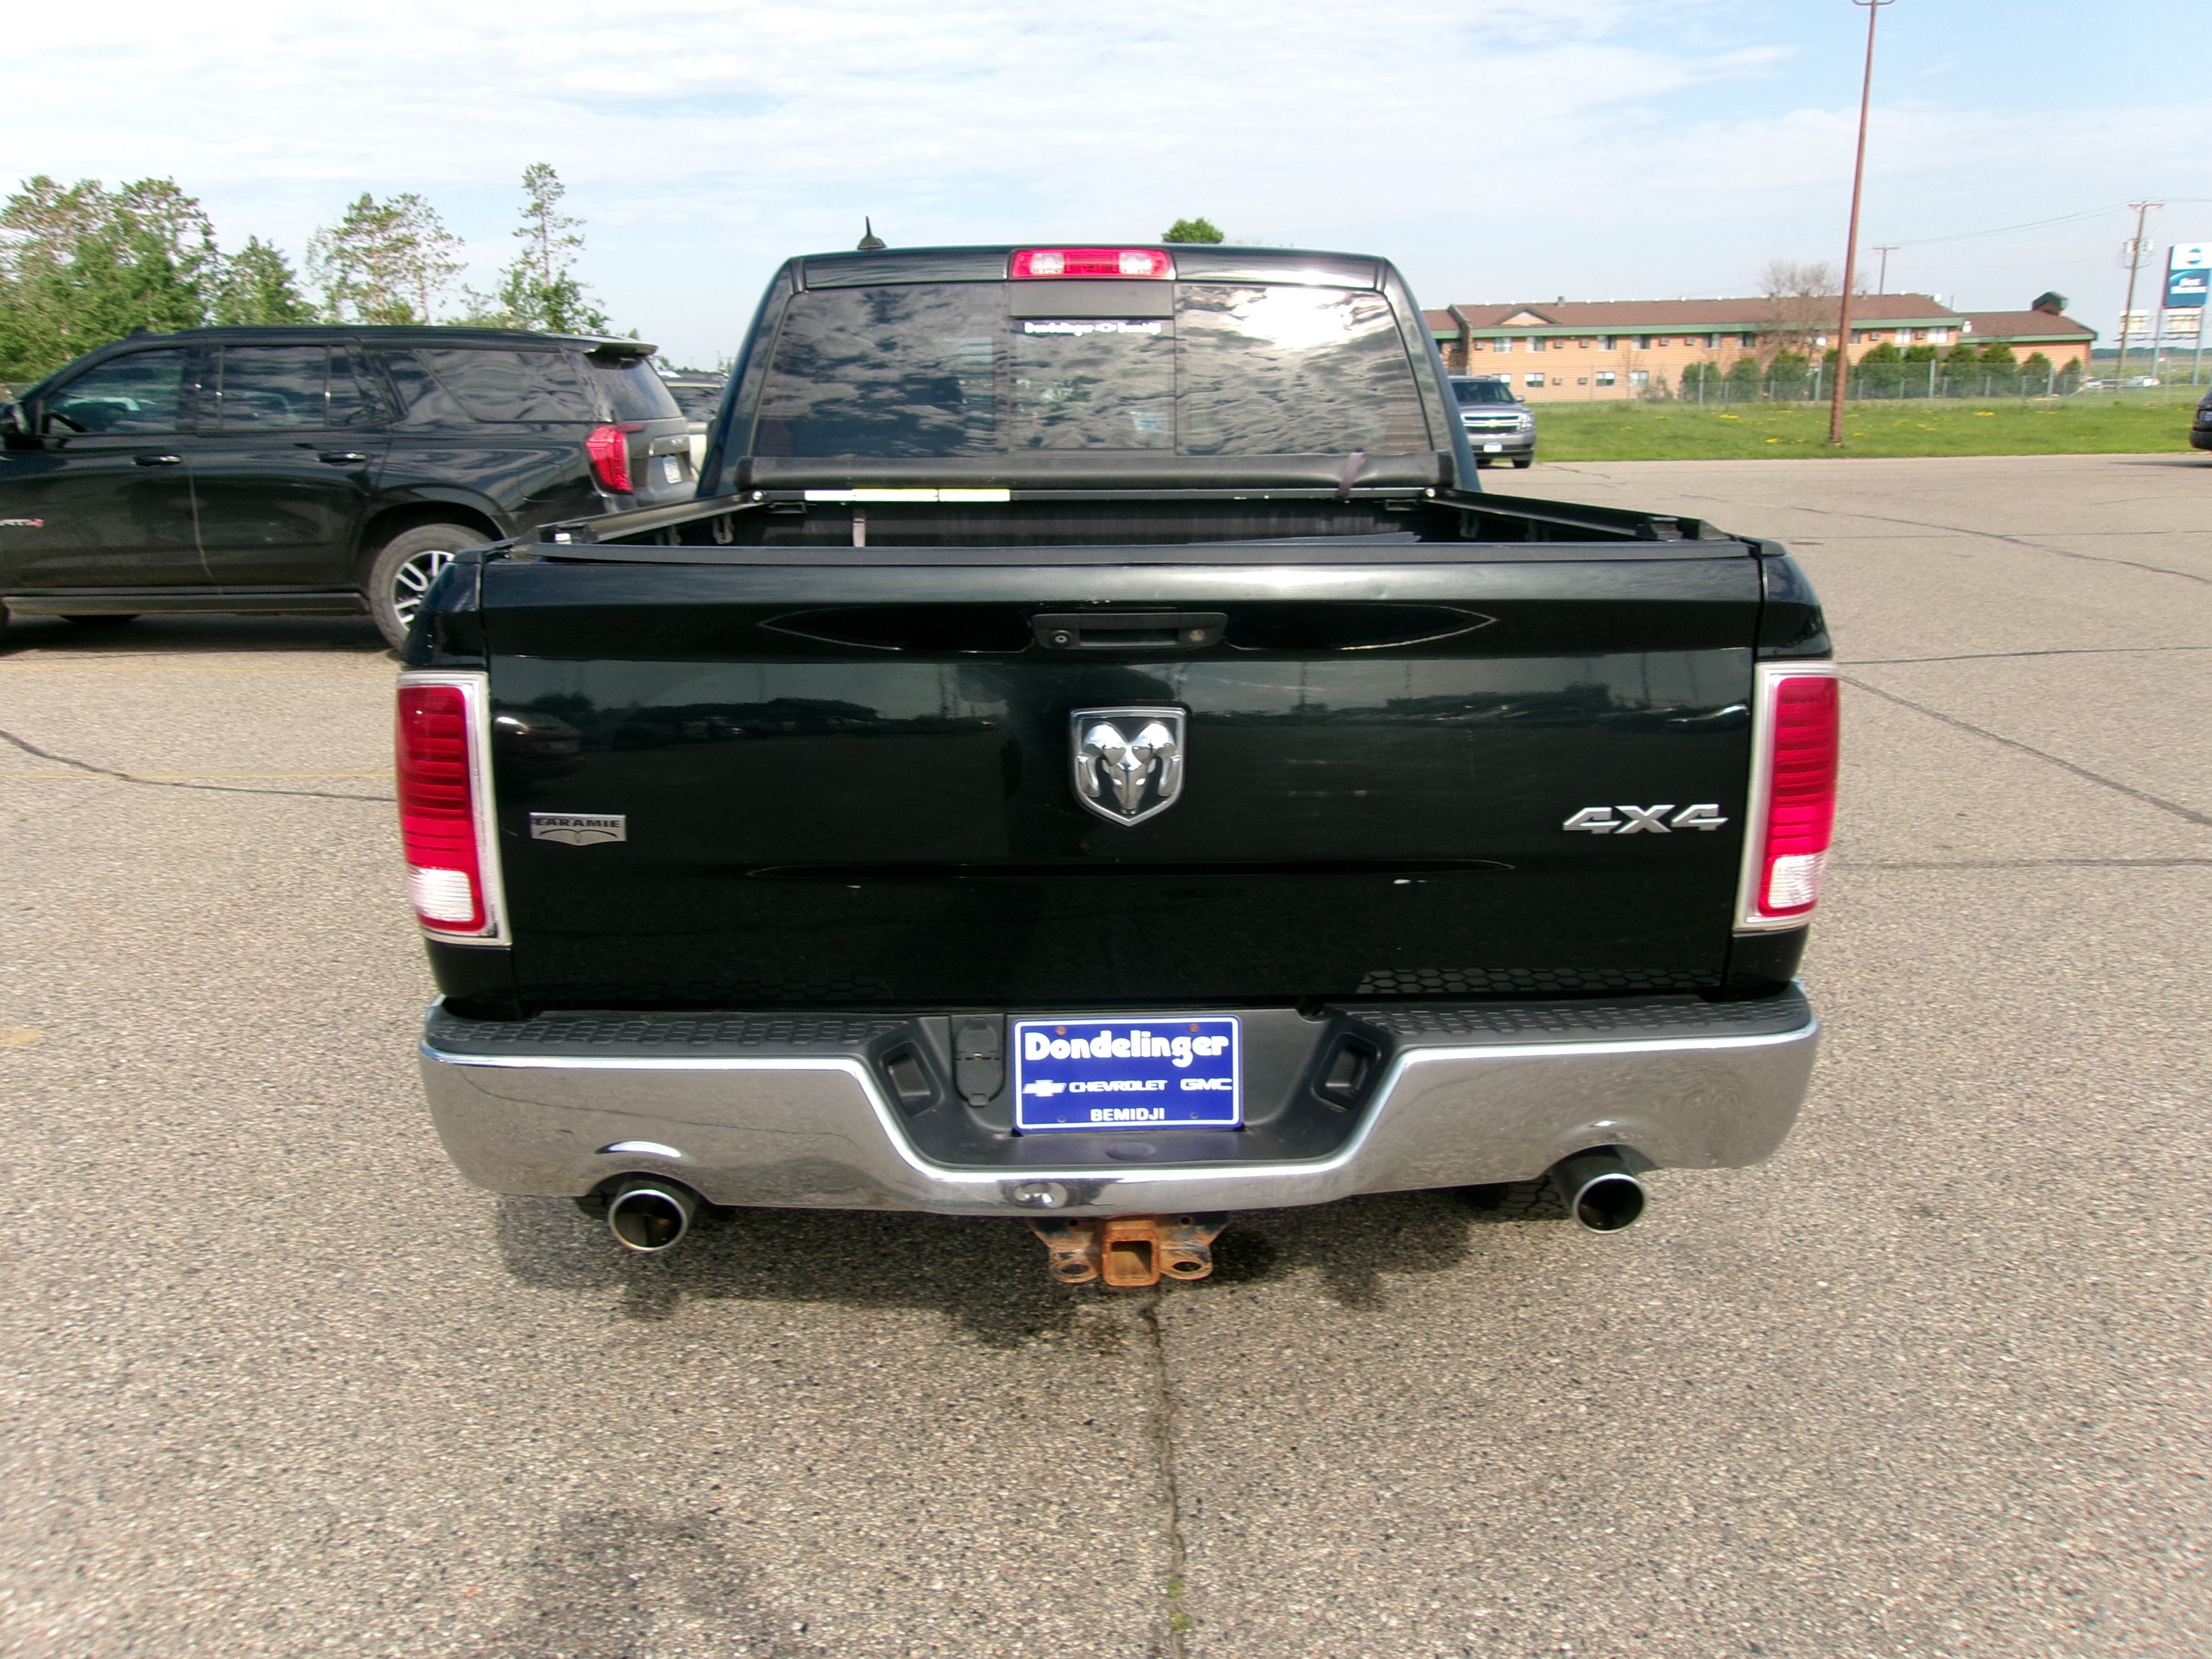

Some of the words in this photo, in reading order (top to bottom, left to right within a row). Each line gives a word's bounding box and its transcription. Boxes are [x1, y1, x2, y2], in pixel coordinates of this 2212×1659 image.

[1563, 804, 1729, 834] 4X4
[1025, 1030, 1229, 1068] Dondelinger
[1069, 1080, 1168, 1093] CHEVROLET
[1180, 1078, 1233, 1091] GMC
[1090, 1107, 1165, 1122] BEMIDJI
